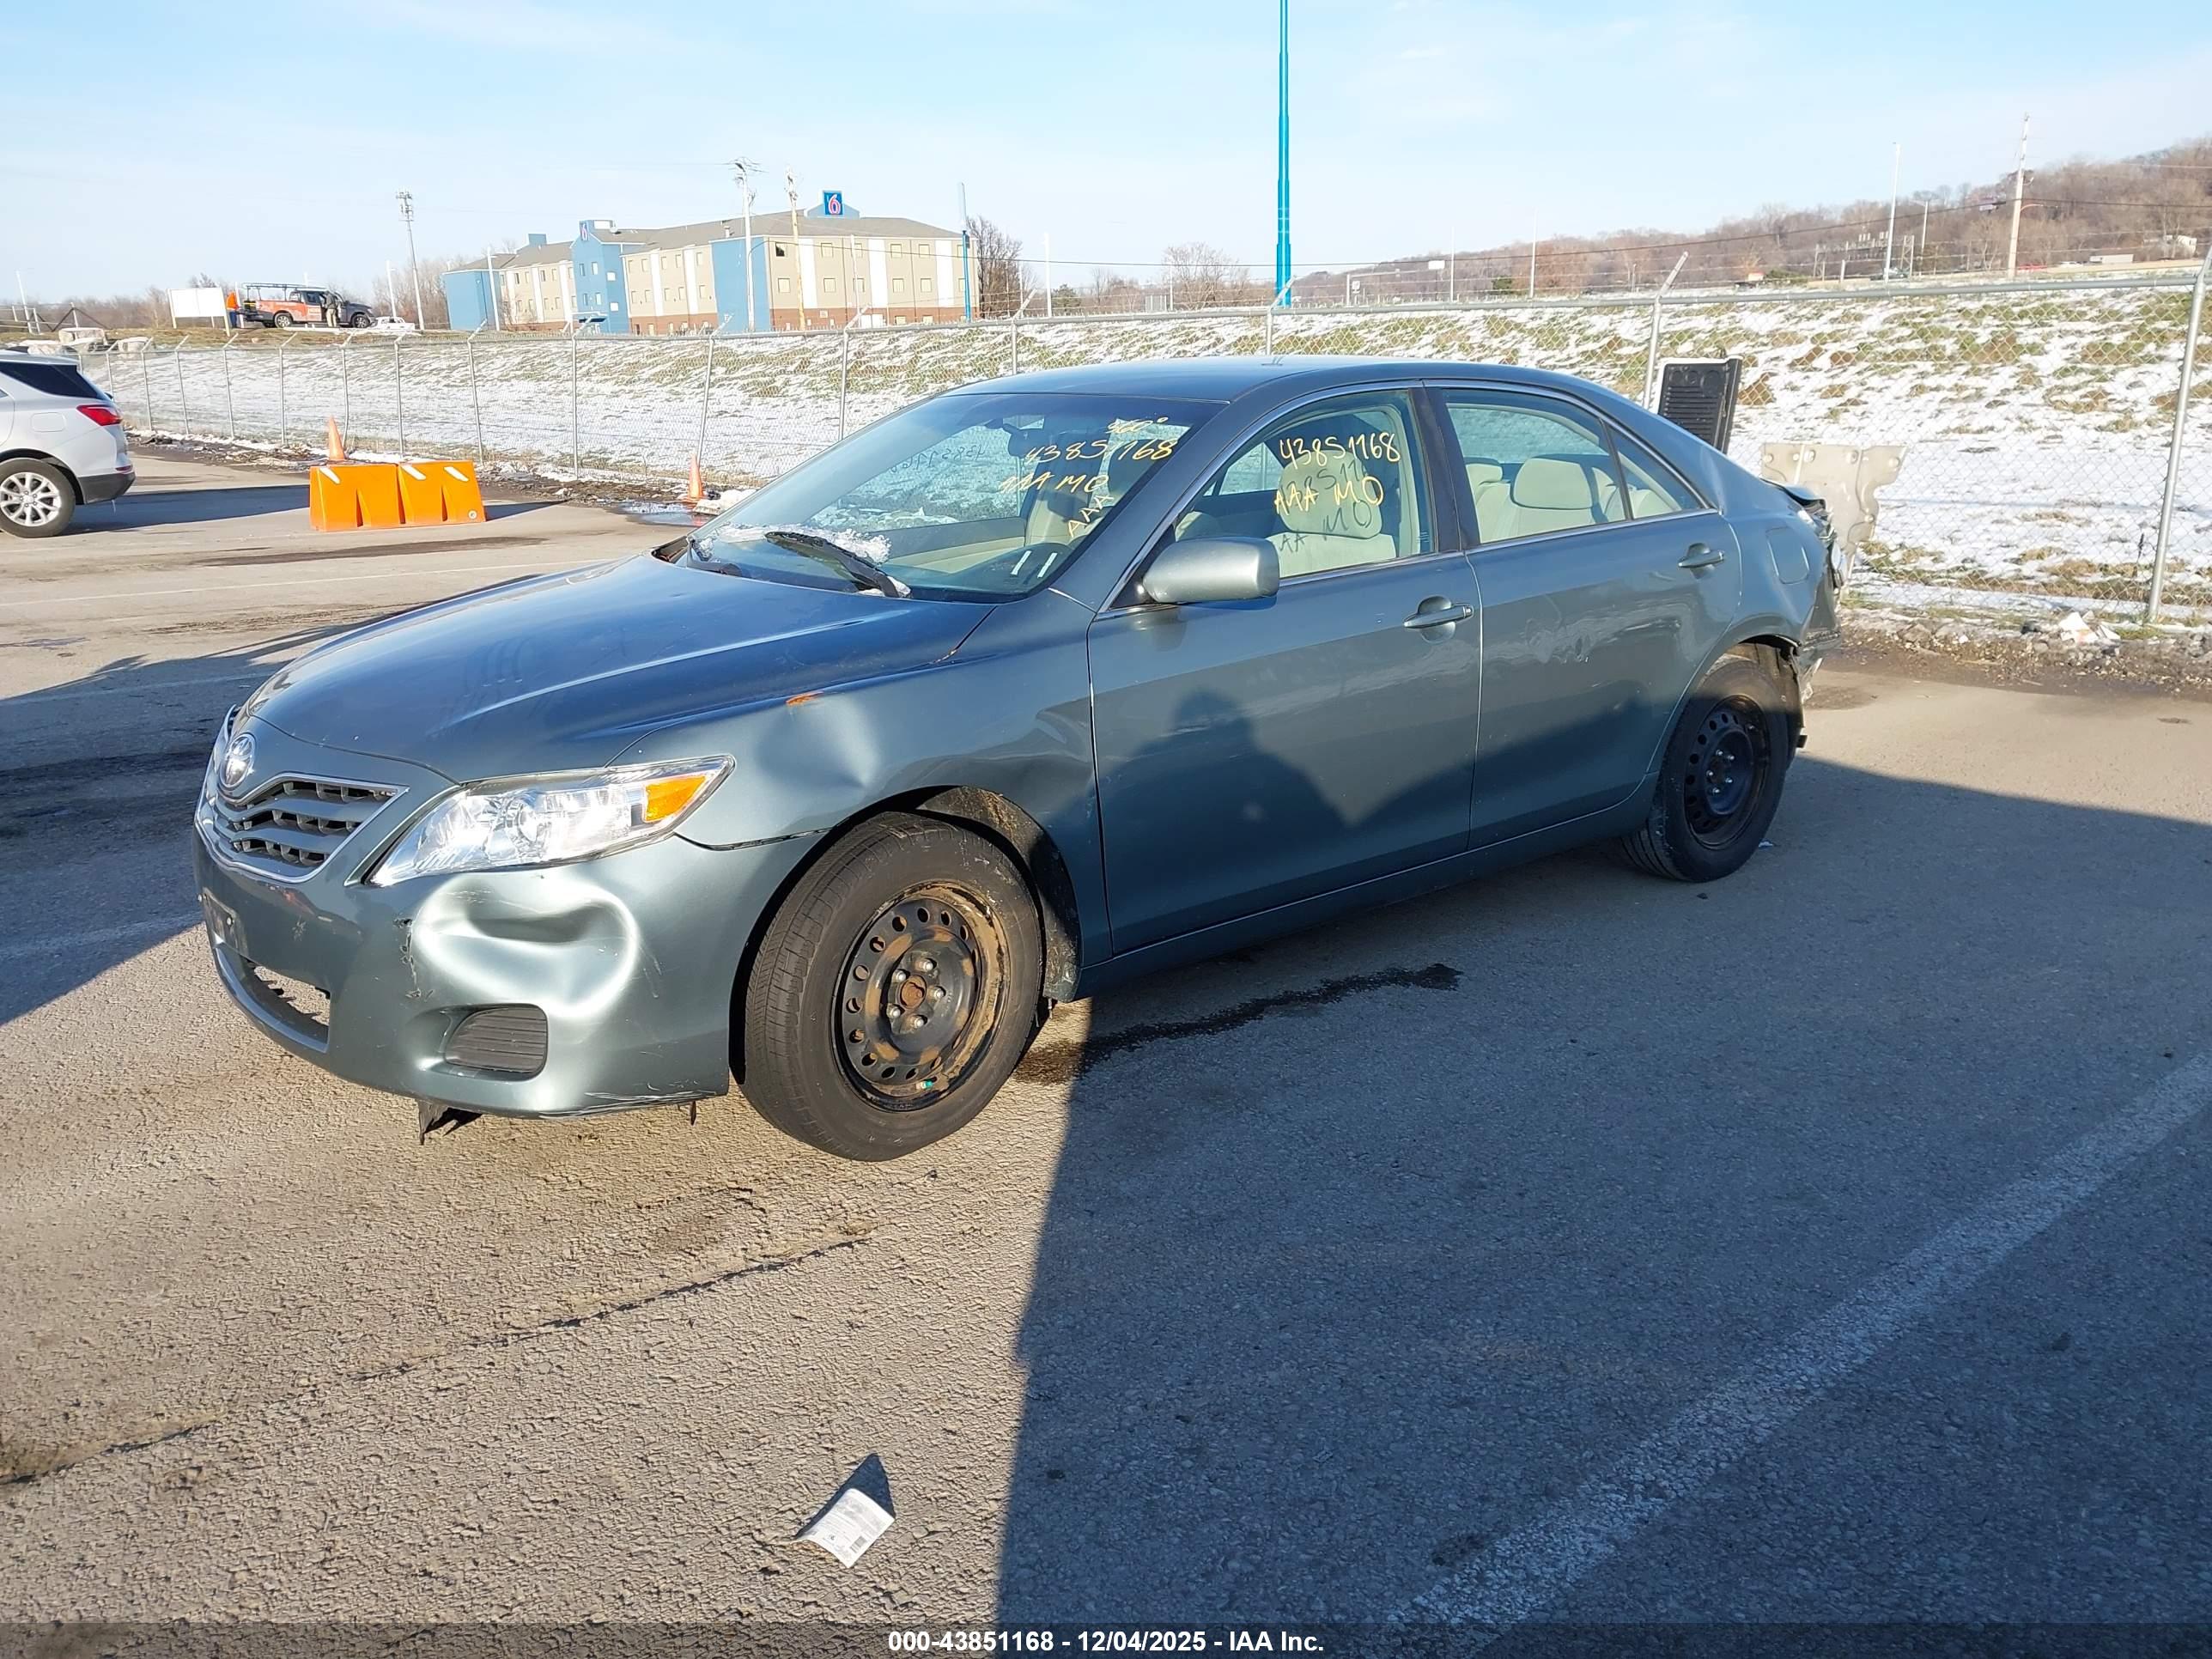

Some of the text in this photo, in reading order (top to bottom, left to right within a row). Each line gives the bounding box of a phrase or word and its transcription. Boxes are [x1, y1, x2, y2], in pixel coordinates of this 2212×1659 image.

[828, 193, 842, 215] 6
[1280, 432, 1401, 470] 43851168
[1274, 481, 1319, 515] AAA
[1334, 476, 1383, 506] MO
